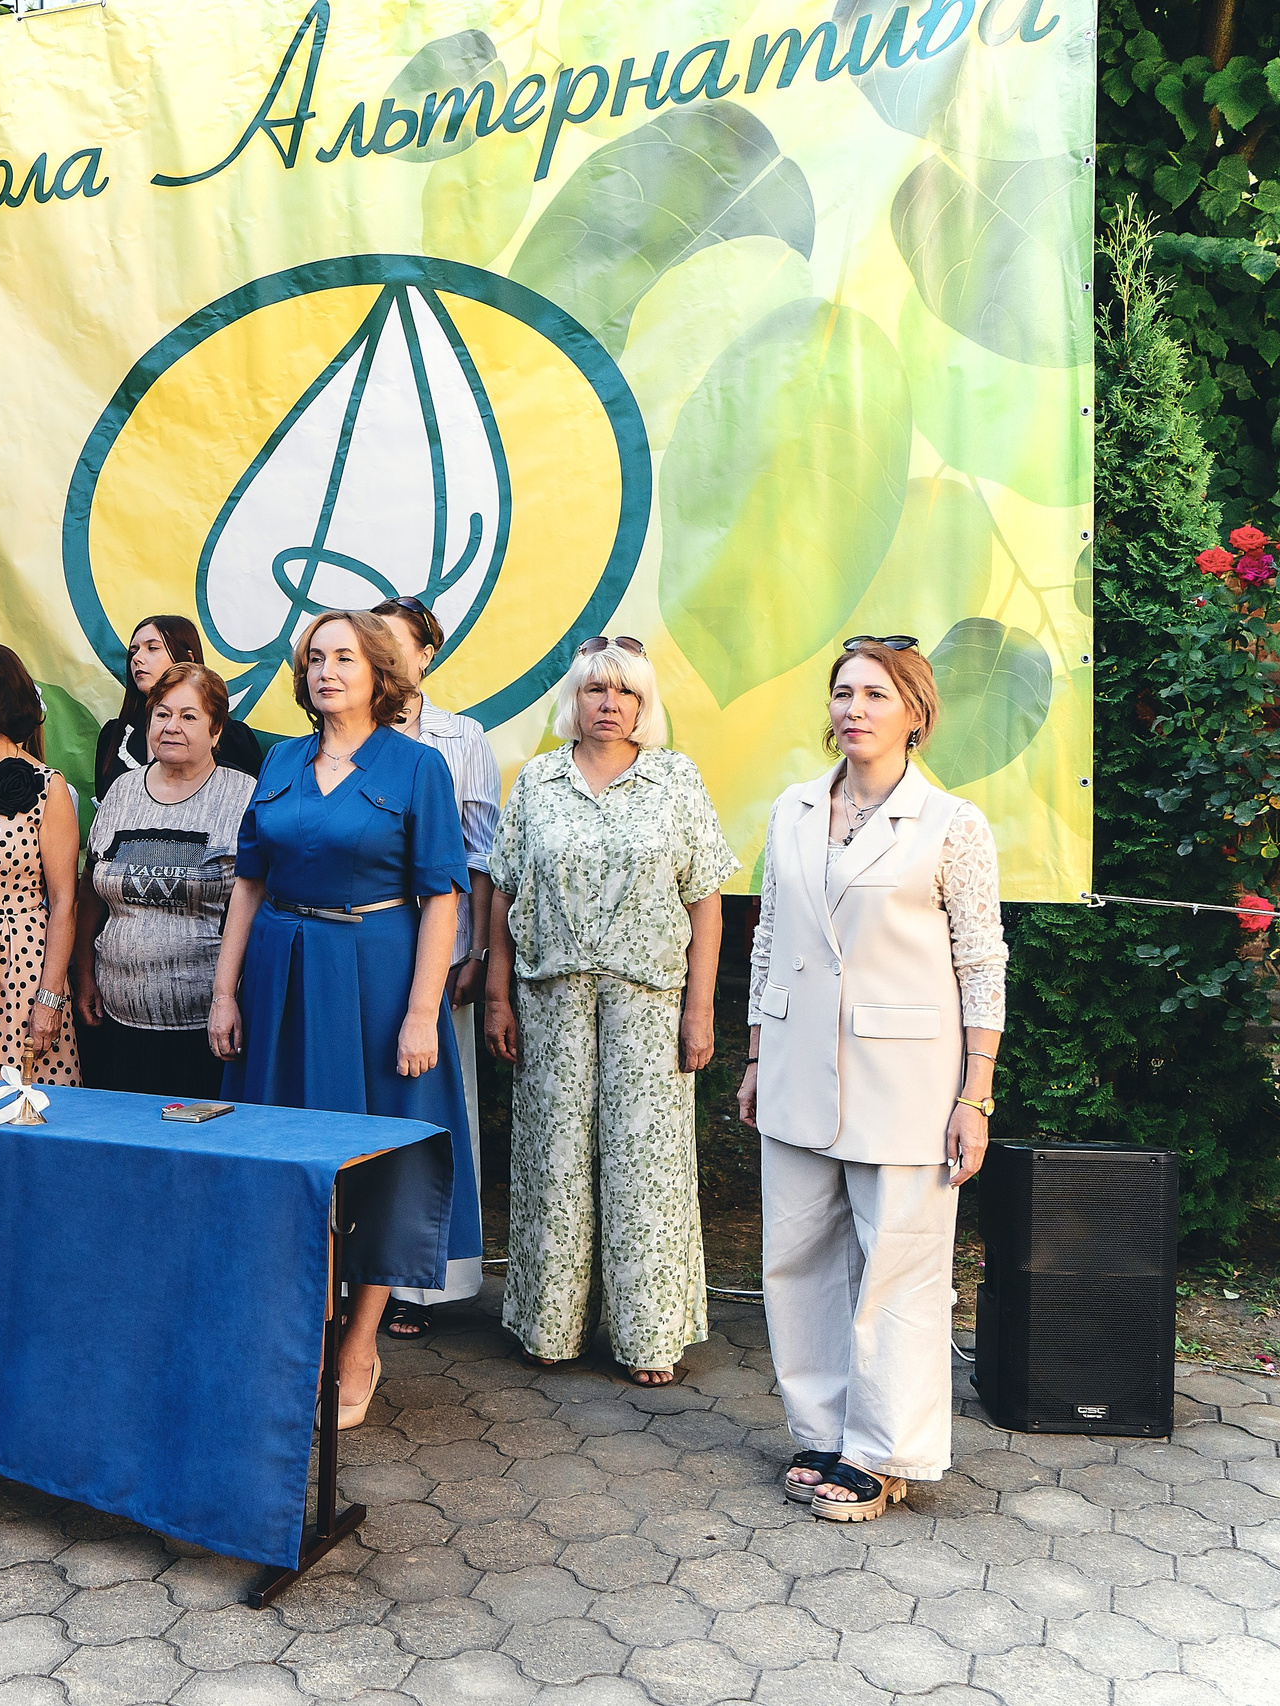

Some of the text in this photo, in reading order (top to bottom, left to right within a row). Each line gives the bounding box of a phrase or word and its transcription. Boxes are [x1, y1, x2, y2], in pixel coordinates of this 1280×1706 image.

[151, 0, 1060, 187] Альтернатива
[129, 864, 187, 878] VAGUE
[1077, 1406, 1107, 1414] QSC
